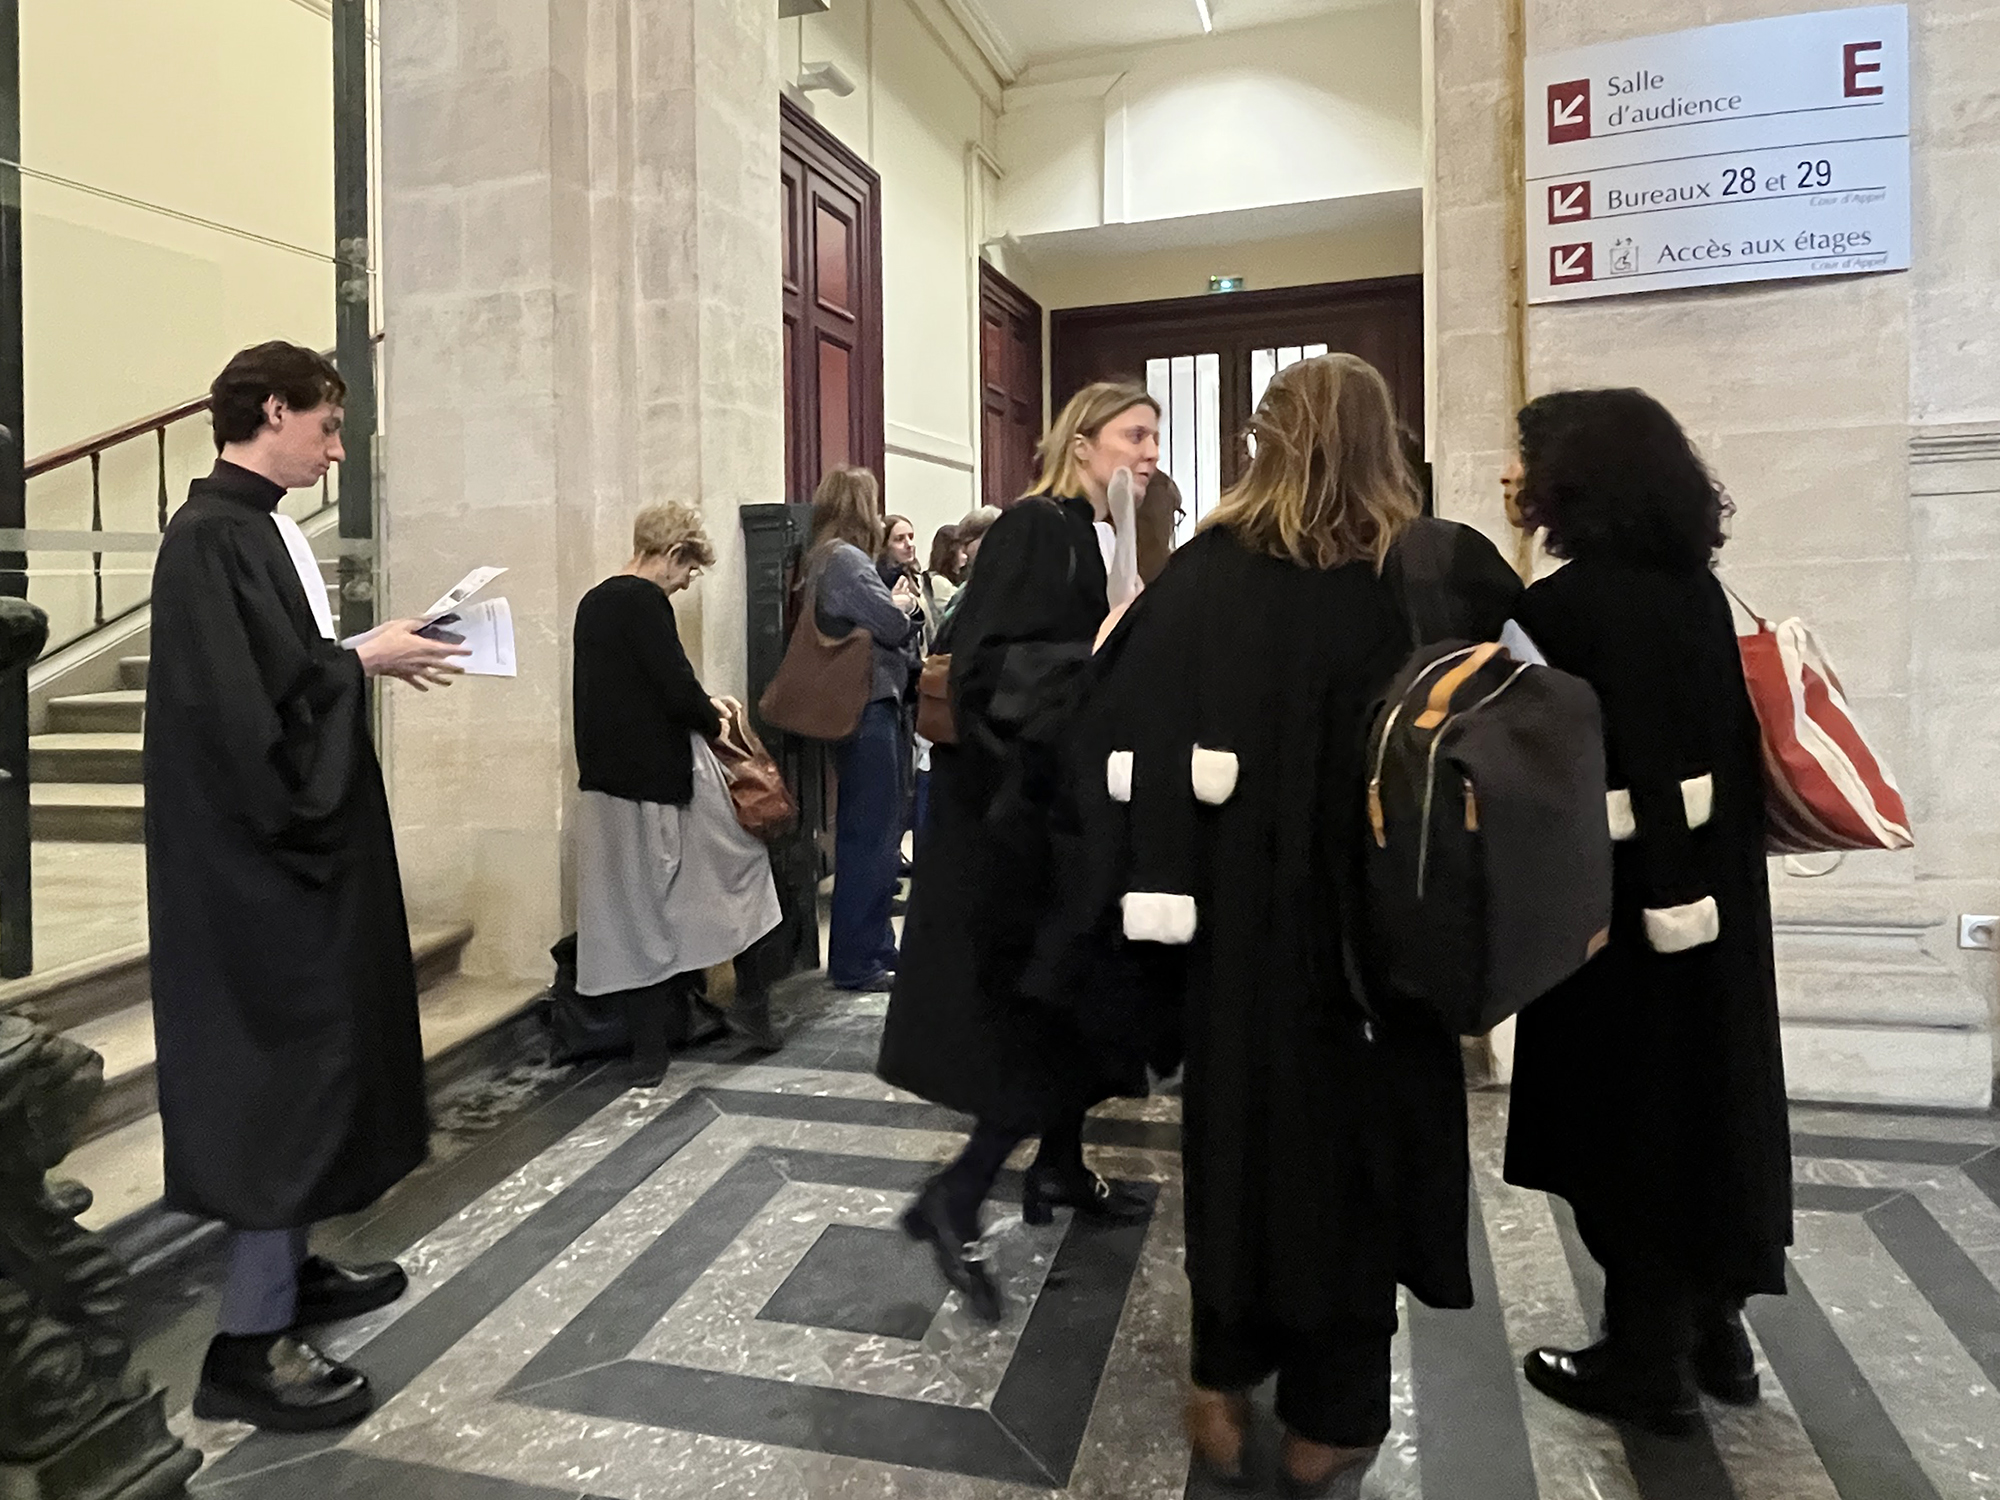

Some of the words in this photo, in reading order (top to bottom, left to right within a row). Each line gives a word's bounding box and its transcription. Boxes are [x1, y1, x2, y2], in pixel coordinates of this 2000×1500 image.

[1608, 70, 1664, 97] Salle
[1843, 41, 1883, 98] E
[1608, 95, 1742, 127] d'audience
[1608, 183, 1711, 210] Bureaux
[1722, 167, 1756, 196] 28
[1765, 174, 1786, 192] et
[1797, 160, 1832, 188] 29
[1657, 239, 1731, 264] Accès
[1741, 239, 1785, 255] aux
[1795, 230, 1872, 254] étages
